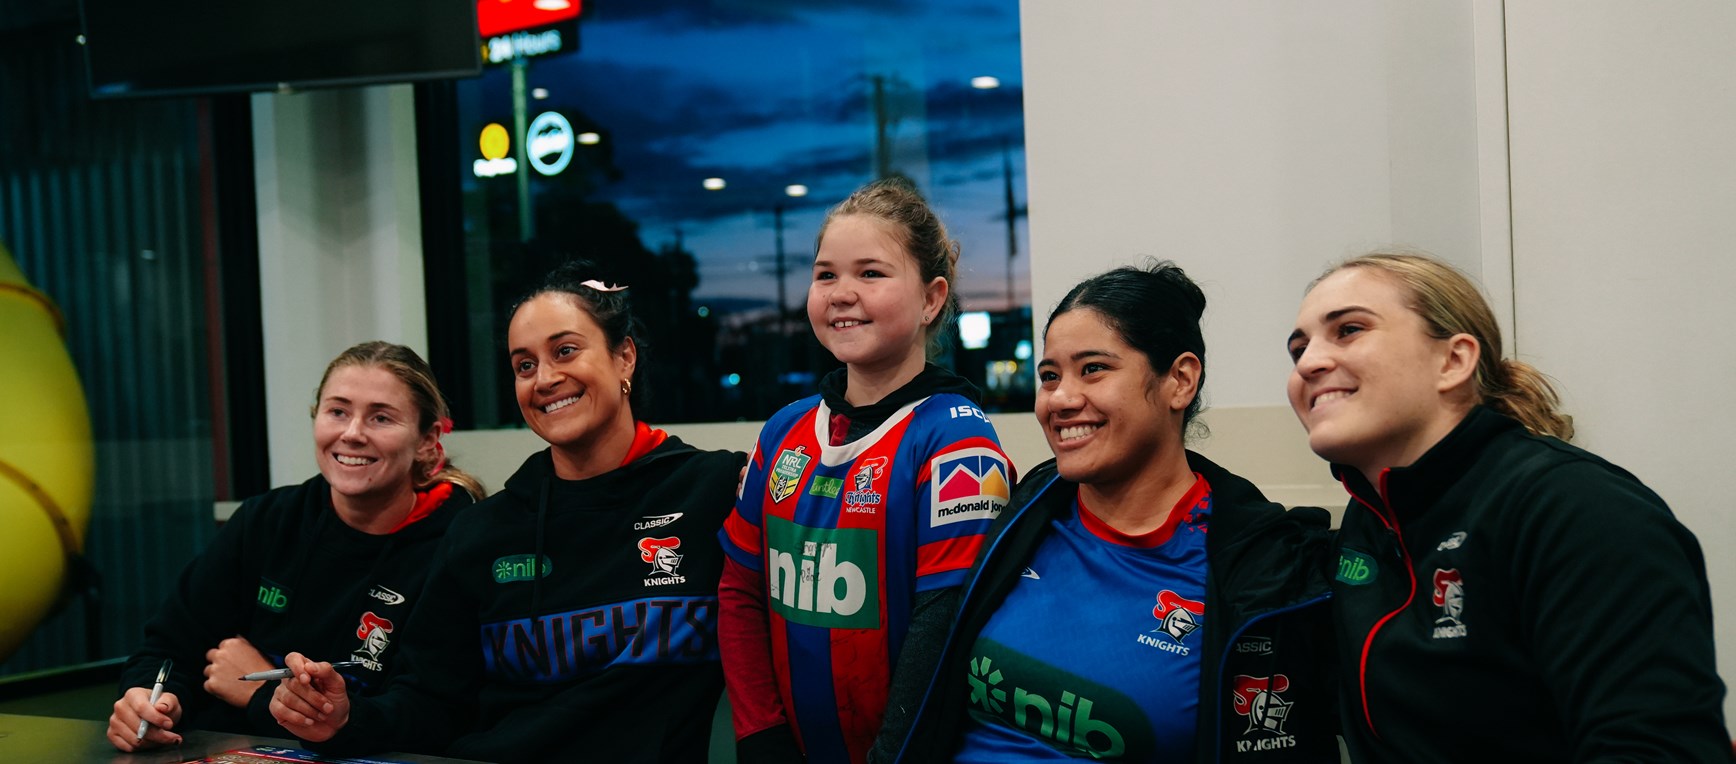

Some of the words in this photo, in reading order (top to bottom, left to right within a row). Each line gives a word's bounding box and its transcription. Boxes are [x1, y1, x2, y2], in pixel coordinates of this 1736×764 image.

[782, 454, 802, 468] NRL
[845, 490, 881, 506] Knights
[845, 506, 876, 514] NEWCASTLE
[938, 500, 990, 517] mcdonald
[634, 516, 670, 531] CLASSIC
[1343, 557, 1369, 580] nib
[644, 575, 686, 587] KNIGHTS
[769, 540, 867, 616] nib
[257, 586, 287, 608] nib
[483, 600, 717, 677] KNIGHTS
[1136, 633, 1191, 657] KNIGHTS
[1013, 686, 1126, 759] nib
[1236, 735, 1297, 753] KNIGHTS
